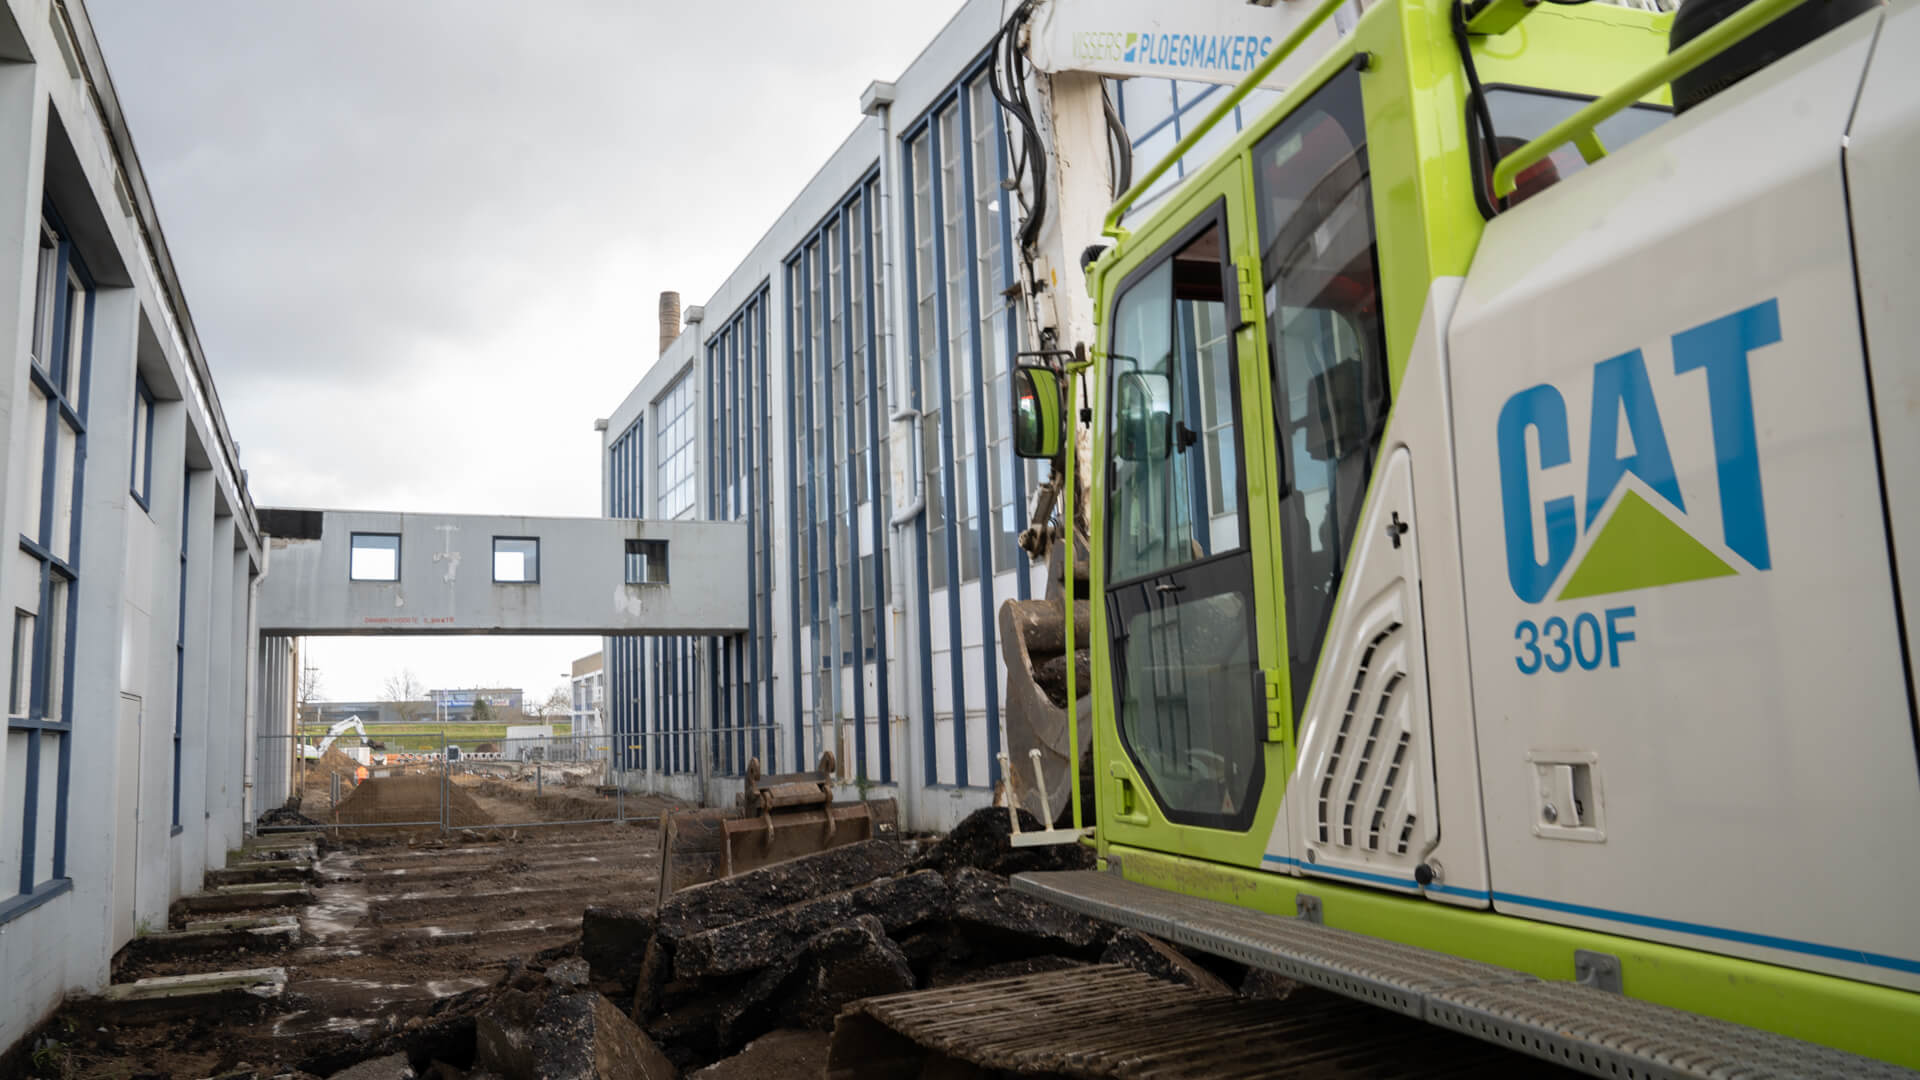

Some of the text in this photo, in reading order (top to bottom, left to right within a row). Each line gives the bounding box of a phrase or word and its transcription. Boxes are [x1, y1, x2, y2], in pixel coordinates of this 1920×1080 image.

[1139, 33, 1272, 71] PLOEGMAKERS
[1497, 297, 1782, 604] CAT
[1514, 605, 1636, 675] 330F
